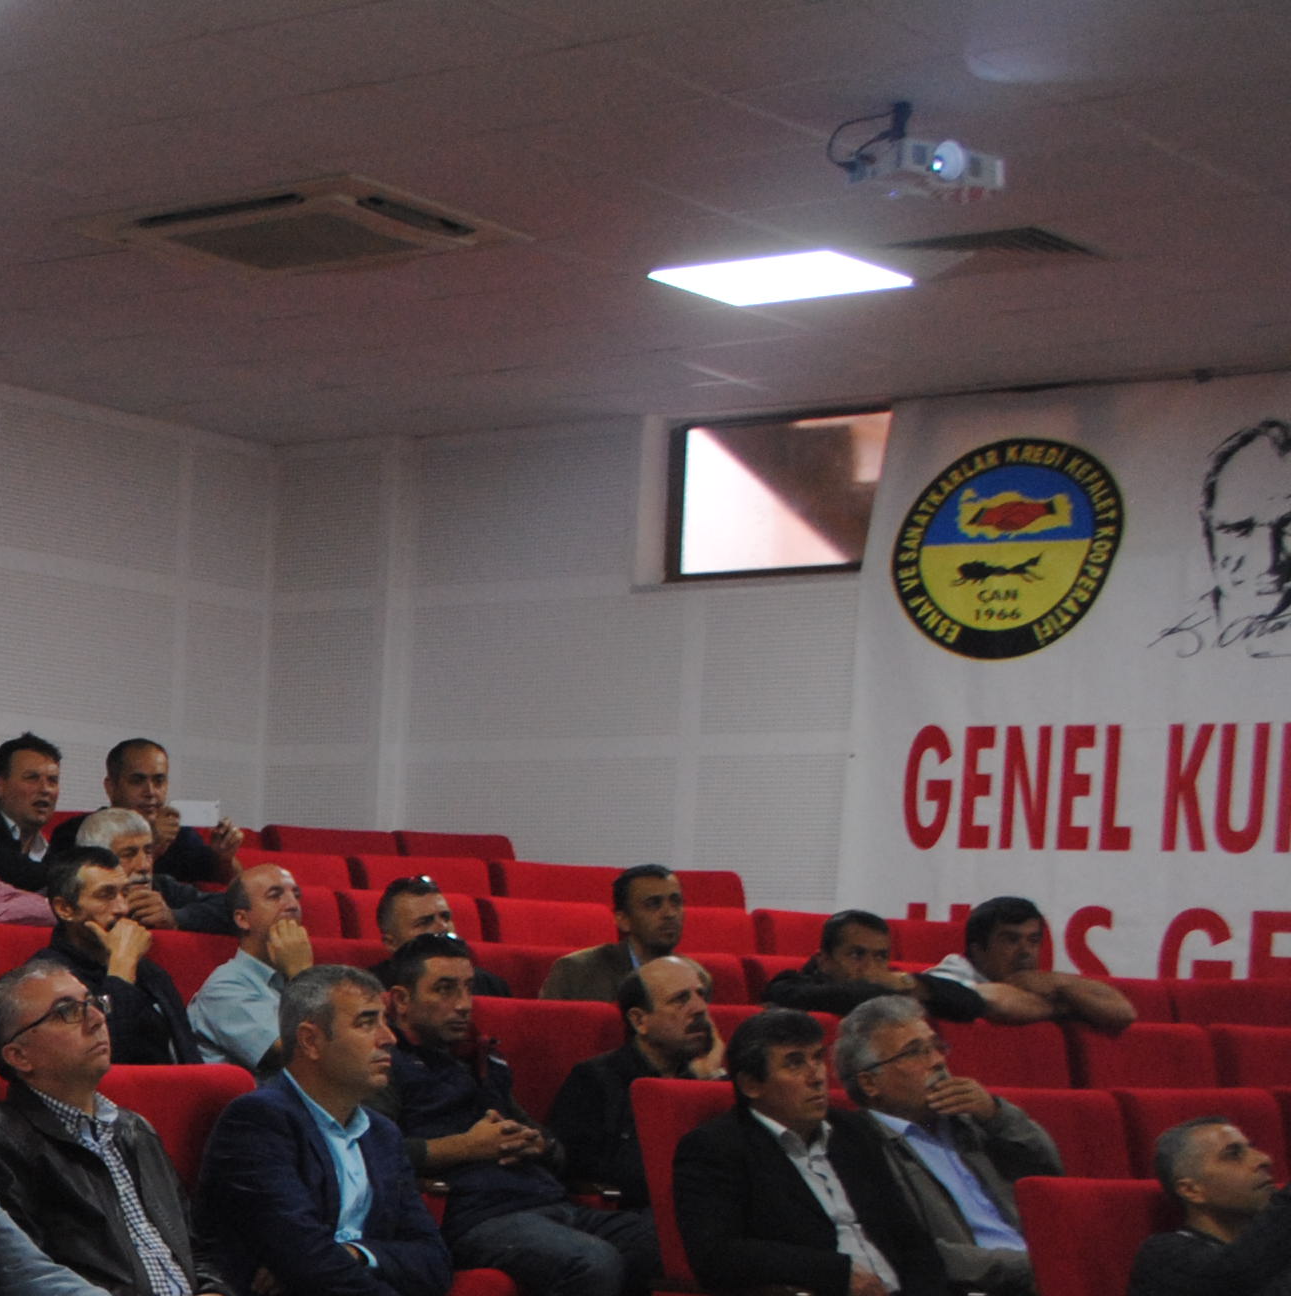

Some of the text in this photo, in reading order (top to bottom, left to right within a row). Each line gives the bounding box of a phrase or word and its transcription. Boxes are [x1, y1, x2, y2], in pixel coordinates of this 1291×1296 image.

[898, 450, 999, 563] SANATKARLAR
[1064, 456, 1118, 522] KEFALET
[898, 565, 919, 592] VE
[908, 594, 963, 644] ESNAF
[974, 608, 1022, 622] 1966
[904, 722, 1291, 854] GENEL KU
